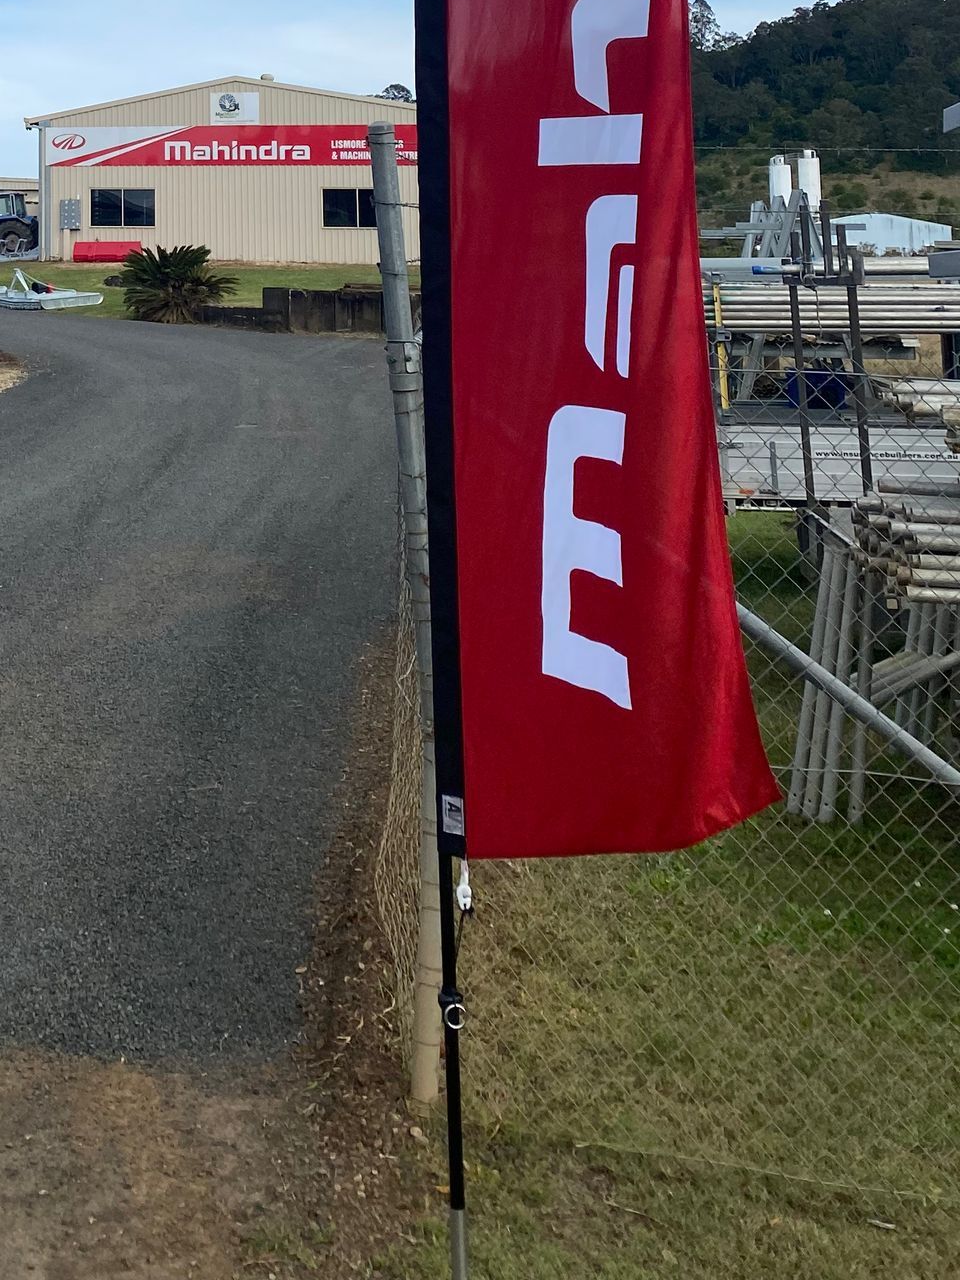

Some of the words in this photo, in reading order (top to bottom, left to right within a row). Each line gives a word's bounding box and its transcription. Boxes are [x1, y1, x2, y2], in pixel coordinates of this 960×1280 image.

[331, 139, 367, 149] LISMORE
[164, 140, 311, 161] Mahindra
[331, 151, 338, 160] &
